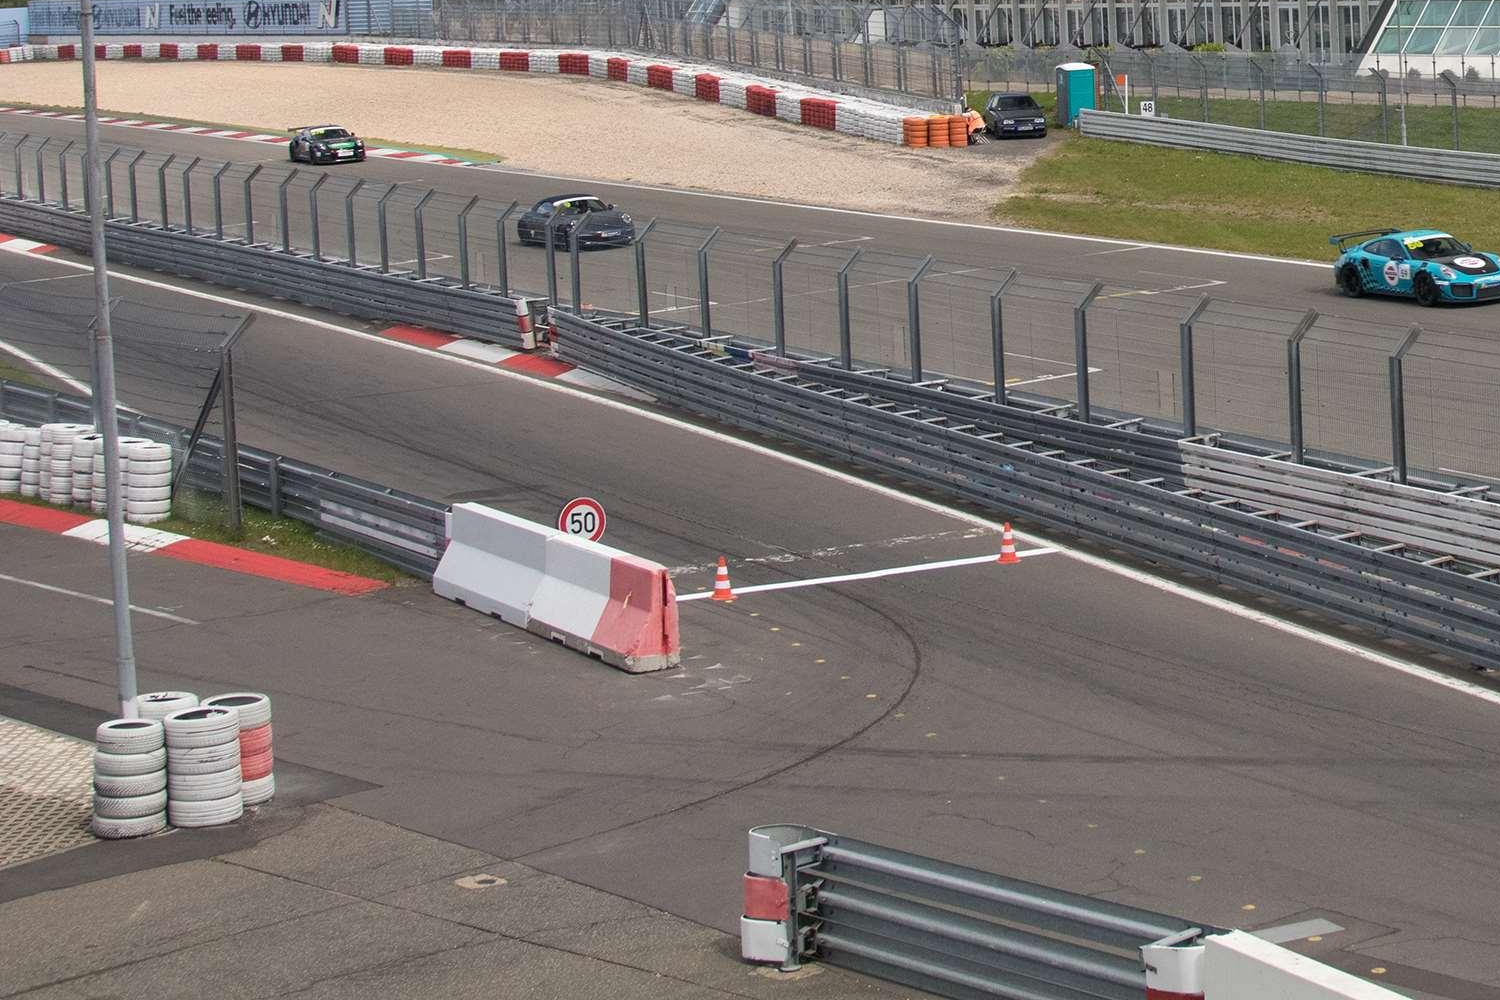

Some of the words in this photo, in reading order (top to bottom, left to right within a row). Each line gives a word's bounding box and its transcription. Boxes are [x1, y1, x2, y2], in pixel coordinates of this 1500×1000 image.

[262, 2, 311, 26] HYUNDAI
[1142, 102, 1153, 113] 48
[571, 512, 596, 534] 50
